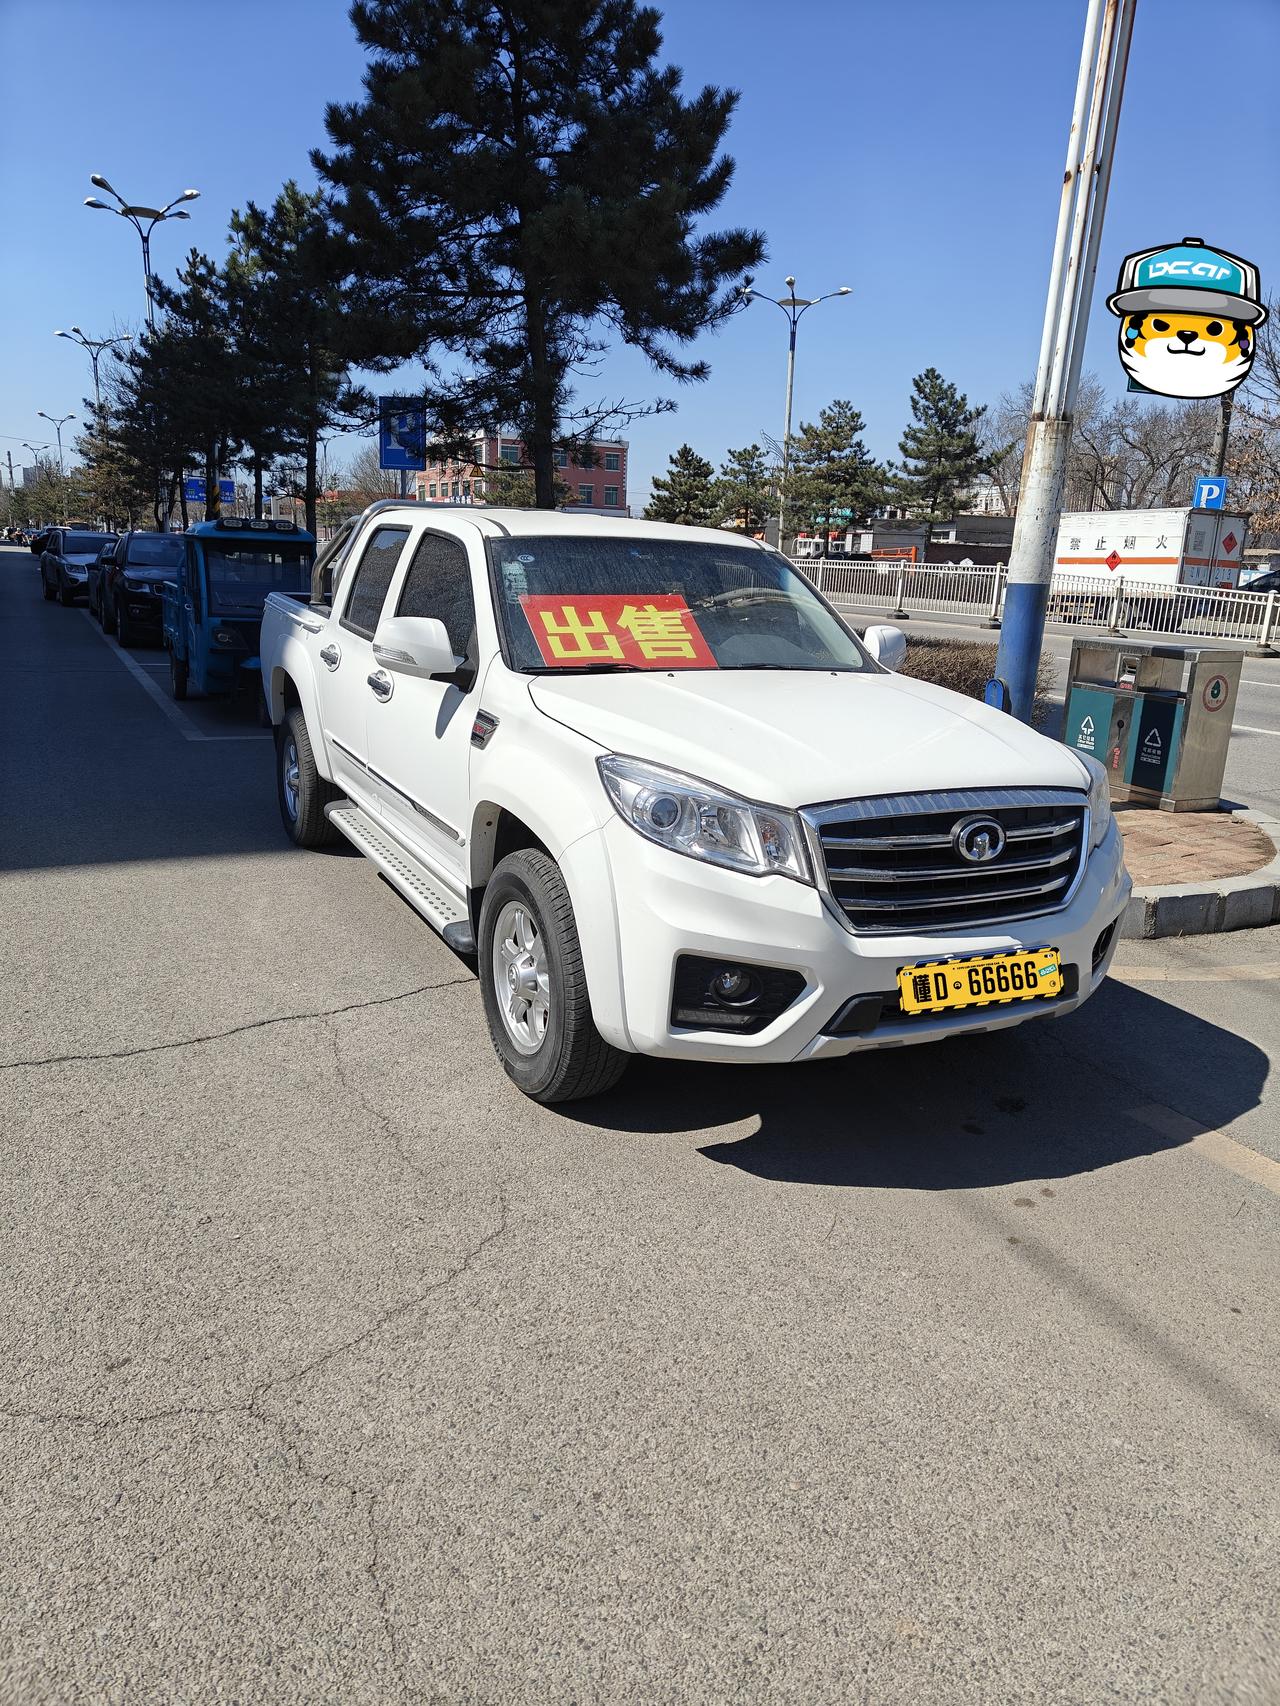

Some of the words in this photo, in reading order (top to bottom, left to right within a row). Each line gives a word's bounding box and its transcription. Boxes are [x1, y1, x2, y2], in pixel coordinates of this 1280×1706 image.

[1199, 484, 1220, 508] P
[1069, 534, 1168, 551] 禁止烟火
[539, 604, 697, 660] 出售
